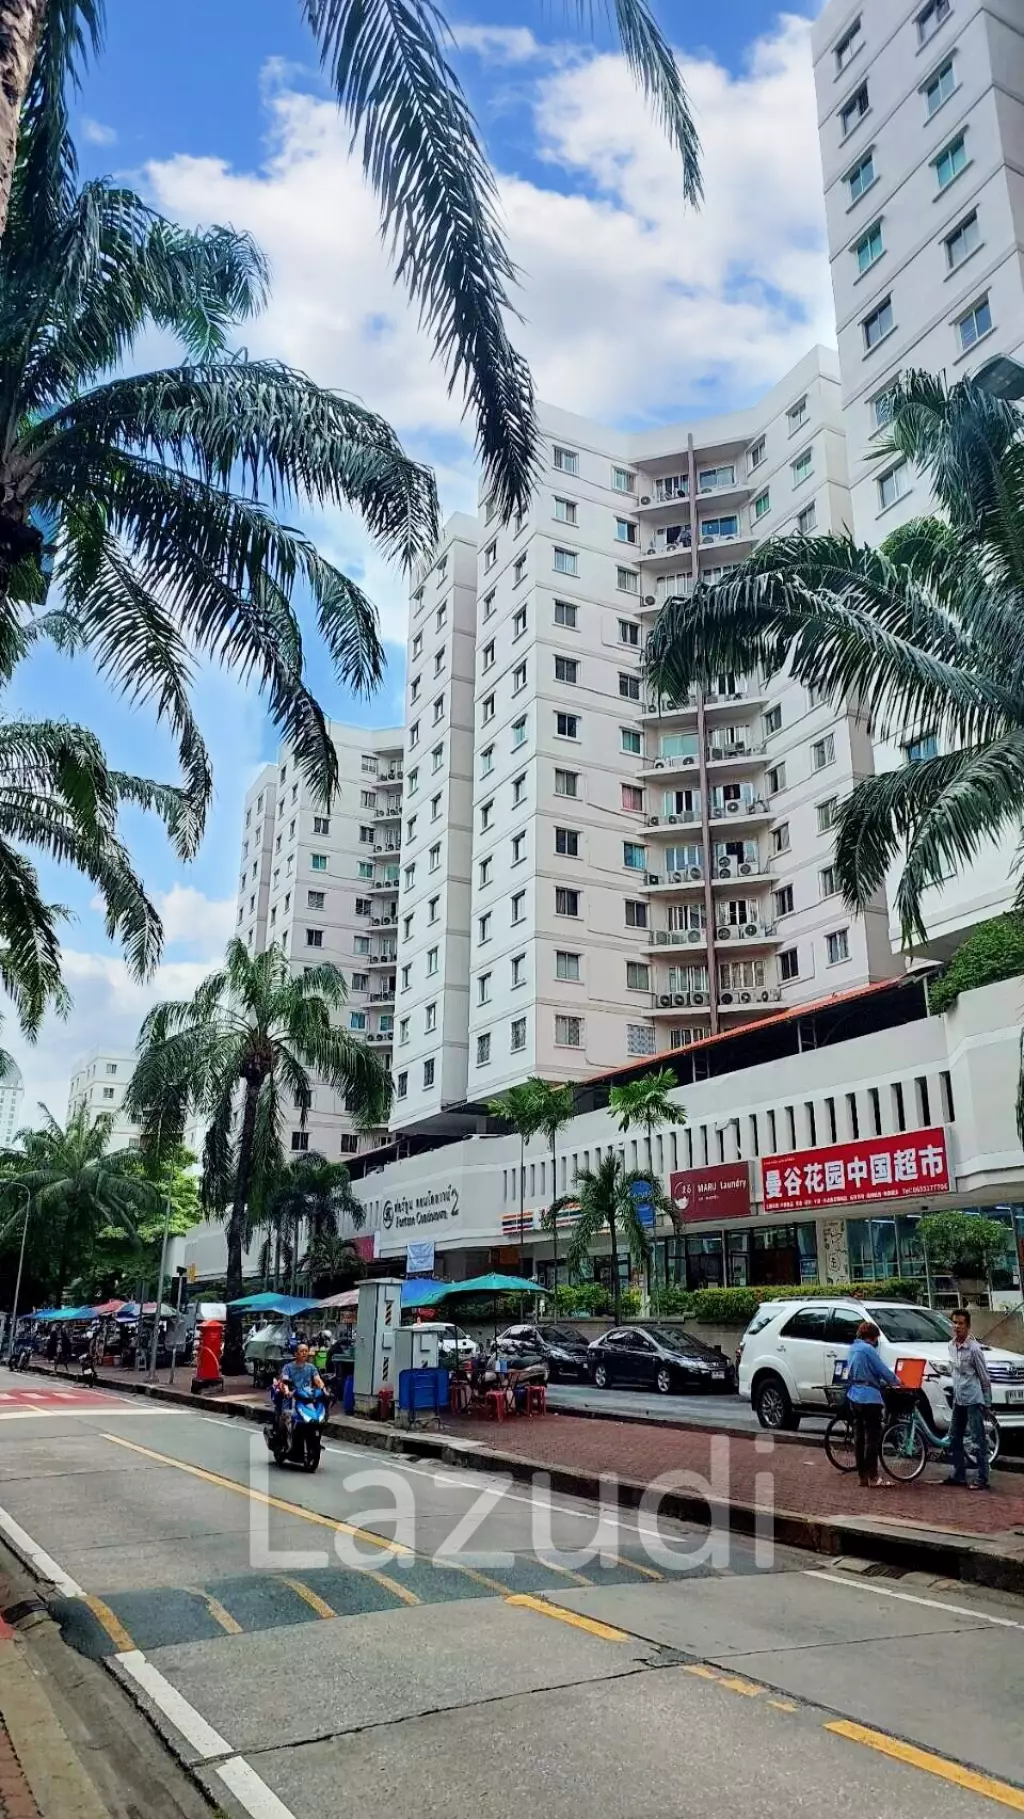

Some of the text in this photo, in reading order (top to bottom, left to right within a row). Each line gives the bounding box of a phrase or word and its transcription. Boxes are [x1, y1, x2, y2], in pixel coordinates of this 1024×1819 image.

[697, 1178, 747, 1193] MARU Laundry
[765, 1144, 944, 1199] 曼谷花园中国超市
[451, 1188, 460, 1217] 2
